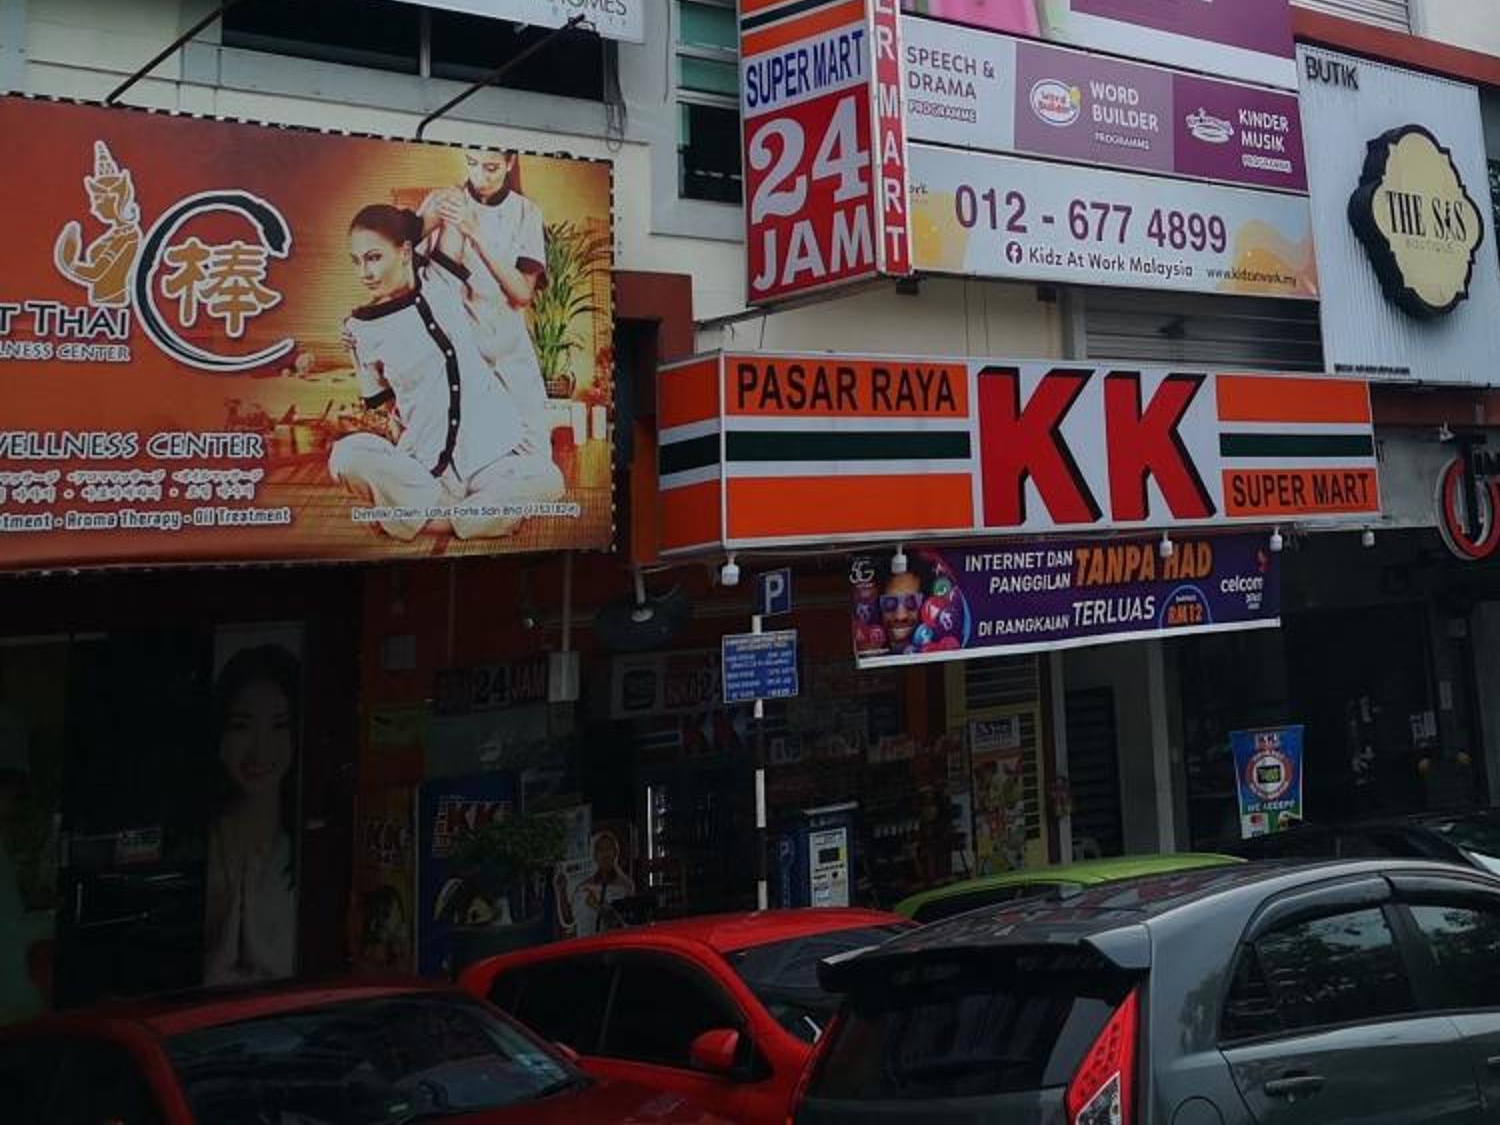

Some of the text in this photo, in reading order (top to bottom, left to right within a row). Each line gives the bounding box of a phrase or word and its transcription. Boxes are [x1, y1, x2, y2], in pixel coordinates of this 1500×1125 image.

[746, 29, 865, 108] SUPER MART
[906, 46, 995, 78] SPEECH &
[1306, 55, 1360, 90] BUTIK
[908, 70, 977, 99] DRAMA
[1089, 79, 1140, 105] WORD
[907, 98, 977, 124] PROGRAMME
[1091, 104, 1159, 132] BUILDER
[1238, 108, 1289, 133] KINDER
[1241, 130, 1286, 153] MUSIK
[748, 96, 872, 226] 24
[955, 184, 1028, 234] 012
[1068, 199, 1133, 244] 677
[1147, 208, 1228, 253] 4899
[1385, 190, 1426, 237] THE
[752, 204, 874, 292] JAM
[1029, 246, 1063, 266] Kidz
[1067, 250, 1085, 268] At
[1088, 252, 1126, 271] Work
[1129, 254, 1194, 280] Malaysia
[162, 237, 282, 338] 棒
[56, 343, 131, 362] CENTER
[736, 363, 957, 413] PASAR RAYA
[147, 433, 264, 458] CENTER
[976, 366, 1218, 527] KK
[1232, 471, 1370, 509] SUPER MART
[66, 511, 119, 529] Aroma
[120, 509, 182, 530] Therapy
[217, 507, 291, 525] Treatment
[965, 550, 1073, 572] INTERNET DAN
[1075, 538, 1214, 587] TANPA HAD
[765, 576, 785, 615] P
[989, 572, 1071, 594] PANGGILAN
[1220, 575, 1264, 594] celcom
[978, 621, 992, 637] DI
[995, 614, 1069, 636] RANGKAIAN
[1072, 595, 1155, 627] TERLUAS
